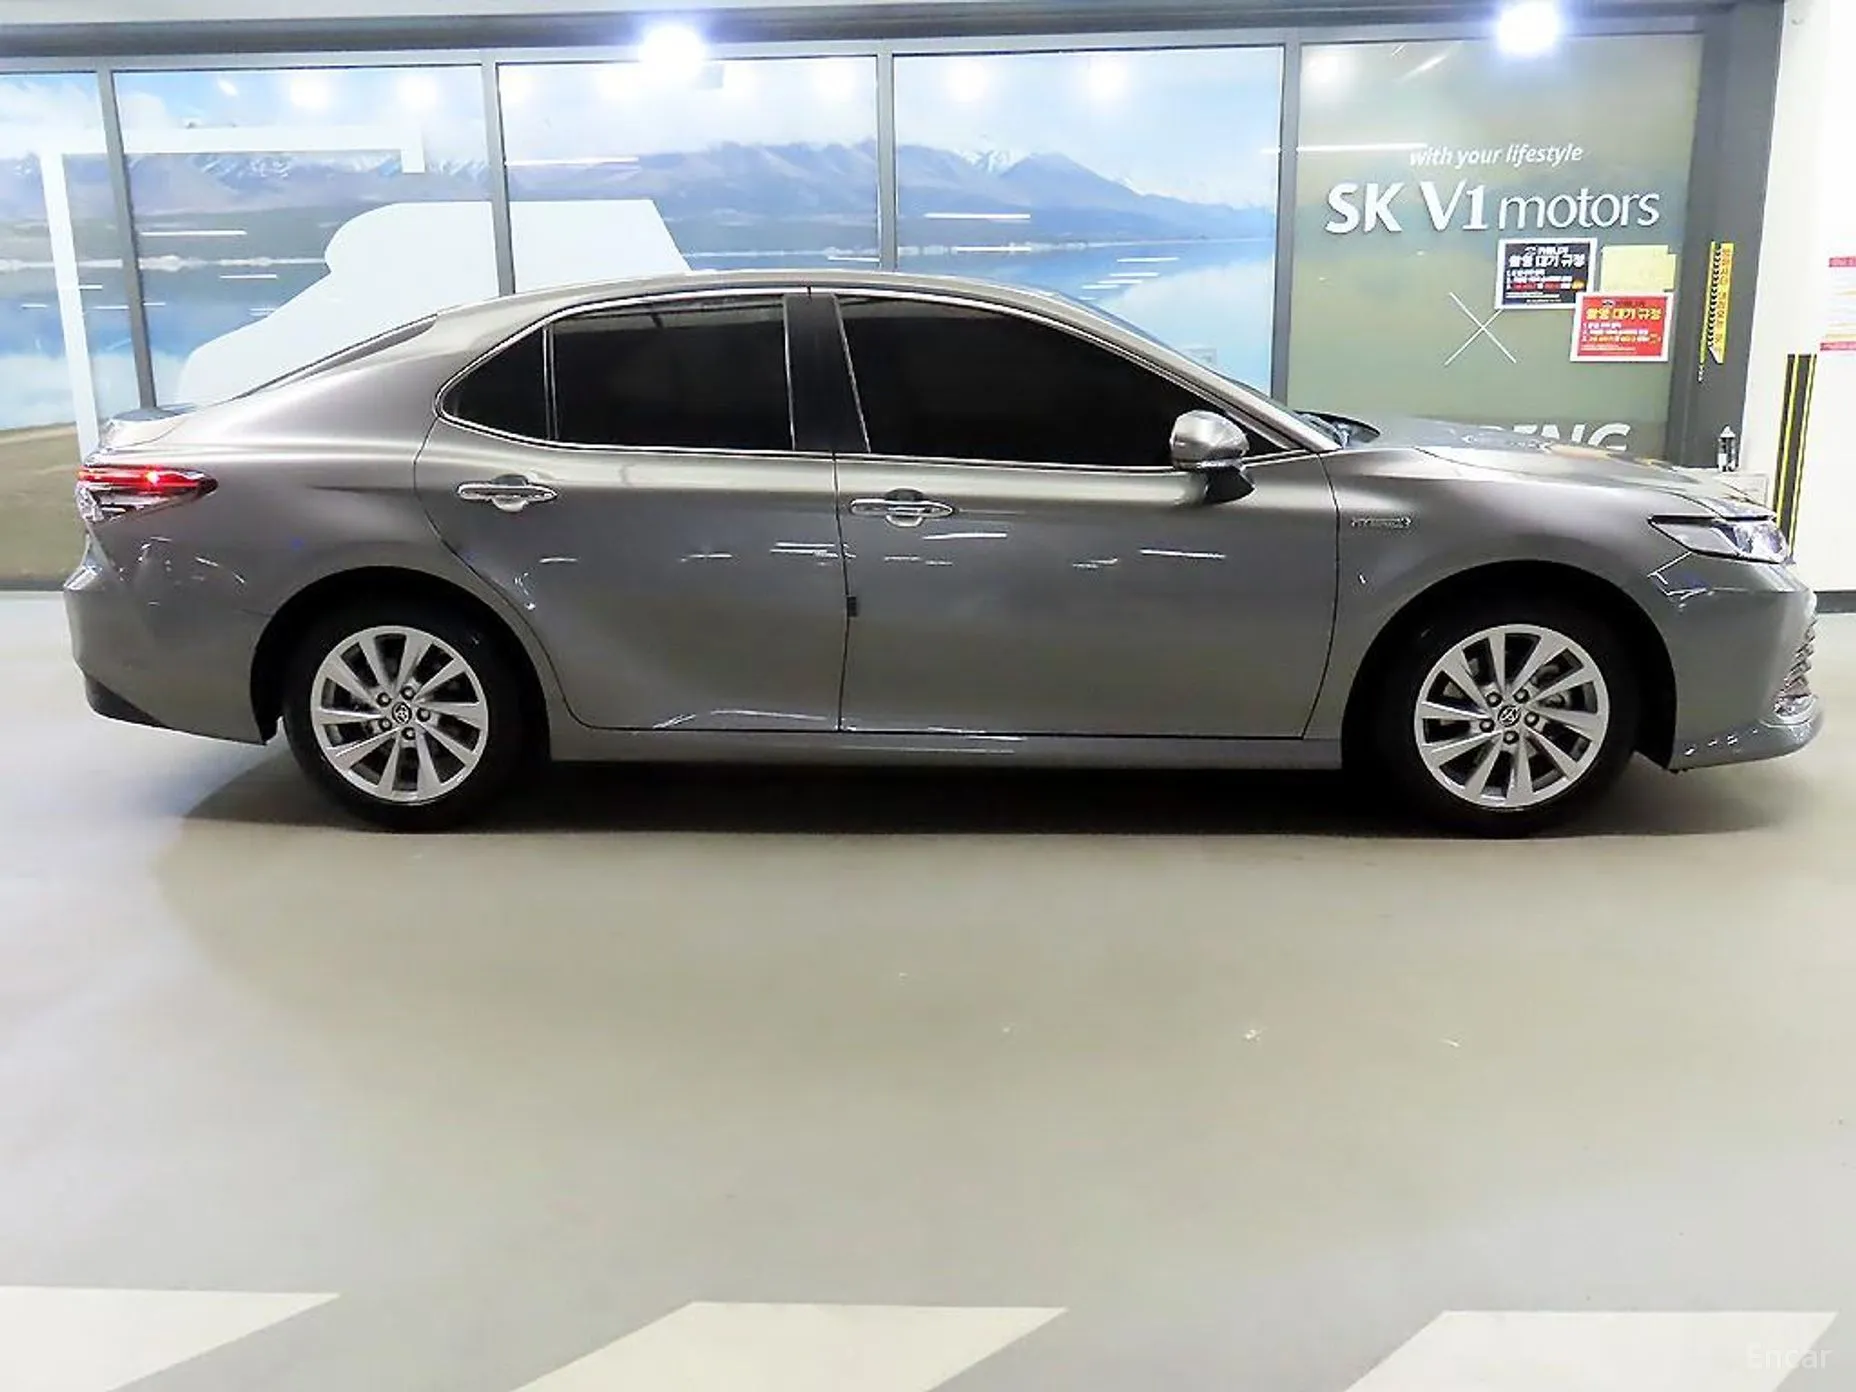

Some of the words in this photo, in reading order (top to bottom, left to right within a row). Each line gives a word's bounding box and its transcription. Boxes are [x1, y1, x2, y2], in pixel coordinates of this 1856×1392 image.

[1409, 145, 1452, 167] with
[1454, 148, 1502, 169] your
[1505, 143, 1584, 168] lifestyle
[1325, 181, 1404, 234] SK
[1420, 179, 1489, 231] V1
[1498, 187, 1661, 230] motors
